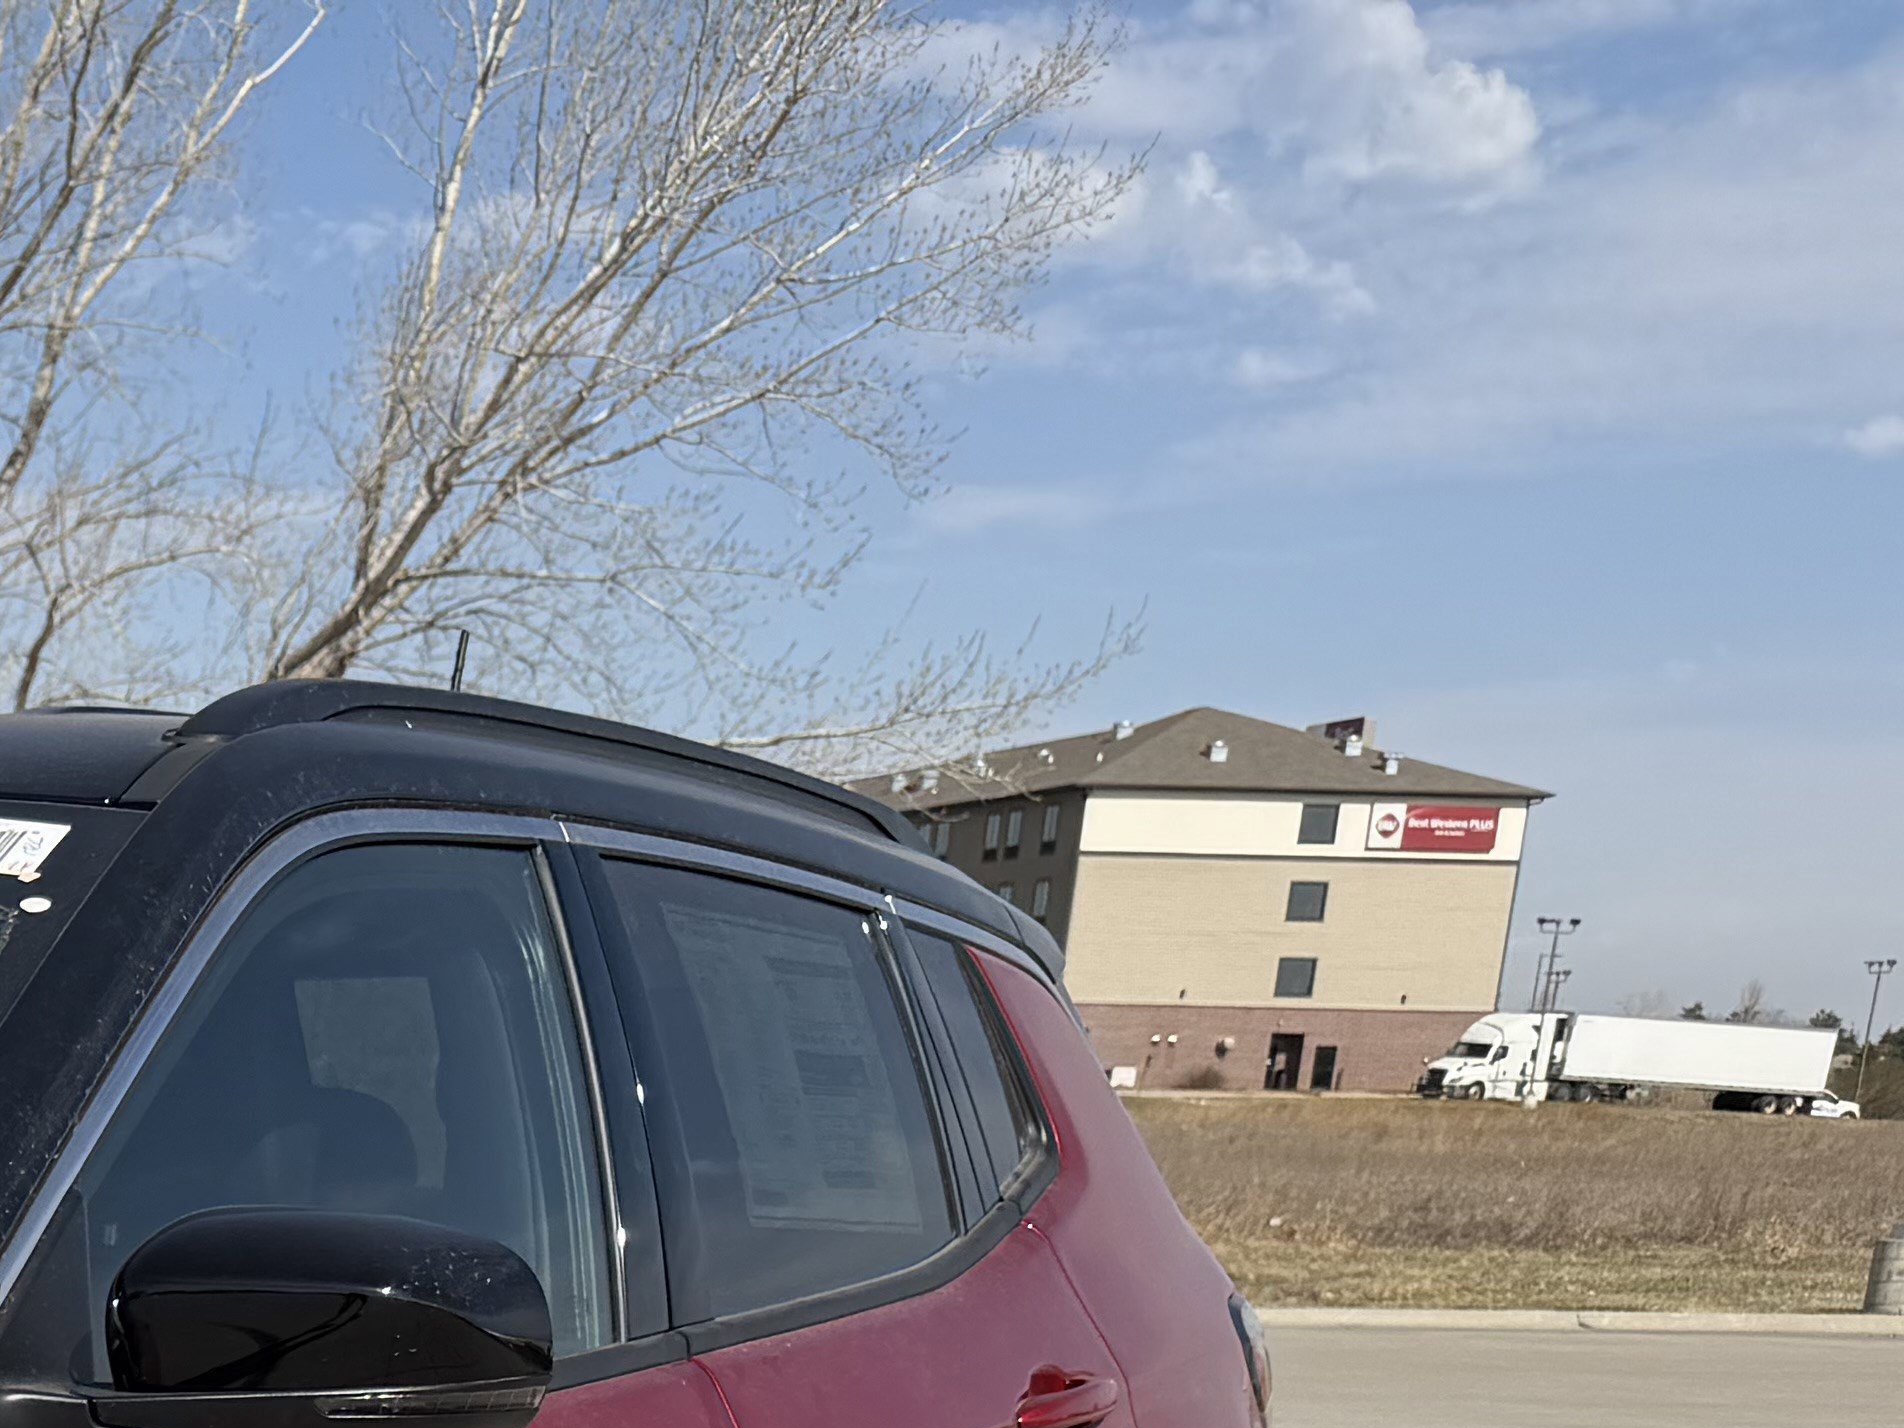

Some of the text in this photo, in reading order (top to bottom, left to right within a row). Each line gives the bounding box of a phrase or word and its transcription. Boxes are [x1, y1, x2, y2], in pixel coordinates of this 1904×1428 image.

[1408, 818, 1494, 830] Best Western PLUS
